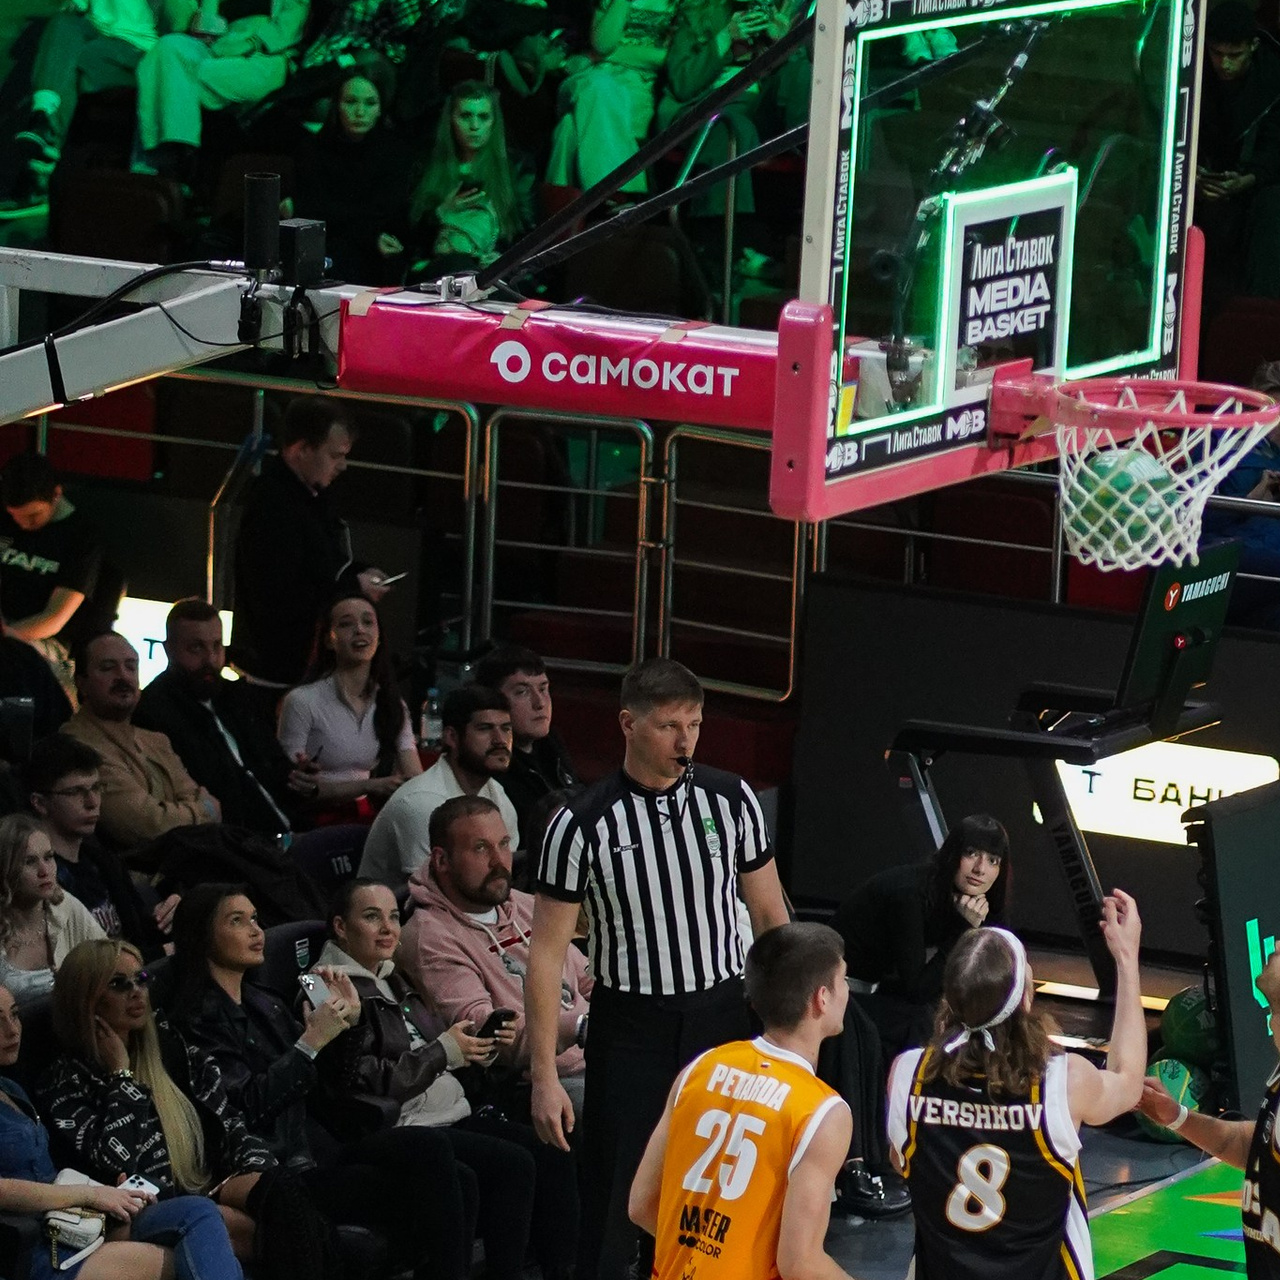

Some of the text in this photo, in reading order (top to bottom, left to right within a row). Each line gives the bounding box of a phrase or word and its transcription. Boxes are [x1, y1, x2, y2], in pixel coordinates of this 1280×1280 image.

[968, 272, 1051, 318] MEDIA
[966, 303, 1051, 345] BASKET
[1181, 571, 1231, 603] YAMAGUCHI
[1132, 777, 1223, 808] БАН
[706, 1063, 792, 1112] PETARDA
[910, 1094, 1043, 1131] VERSHKOV
[682, 1108, 767, 1202] 25
[945, 1143, 1011, 1233] 8
